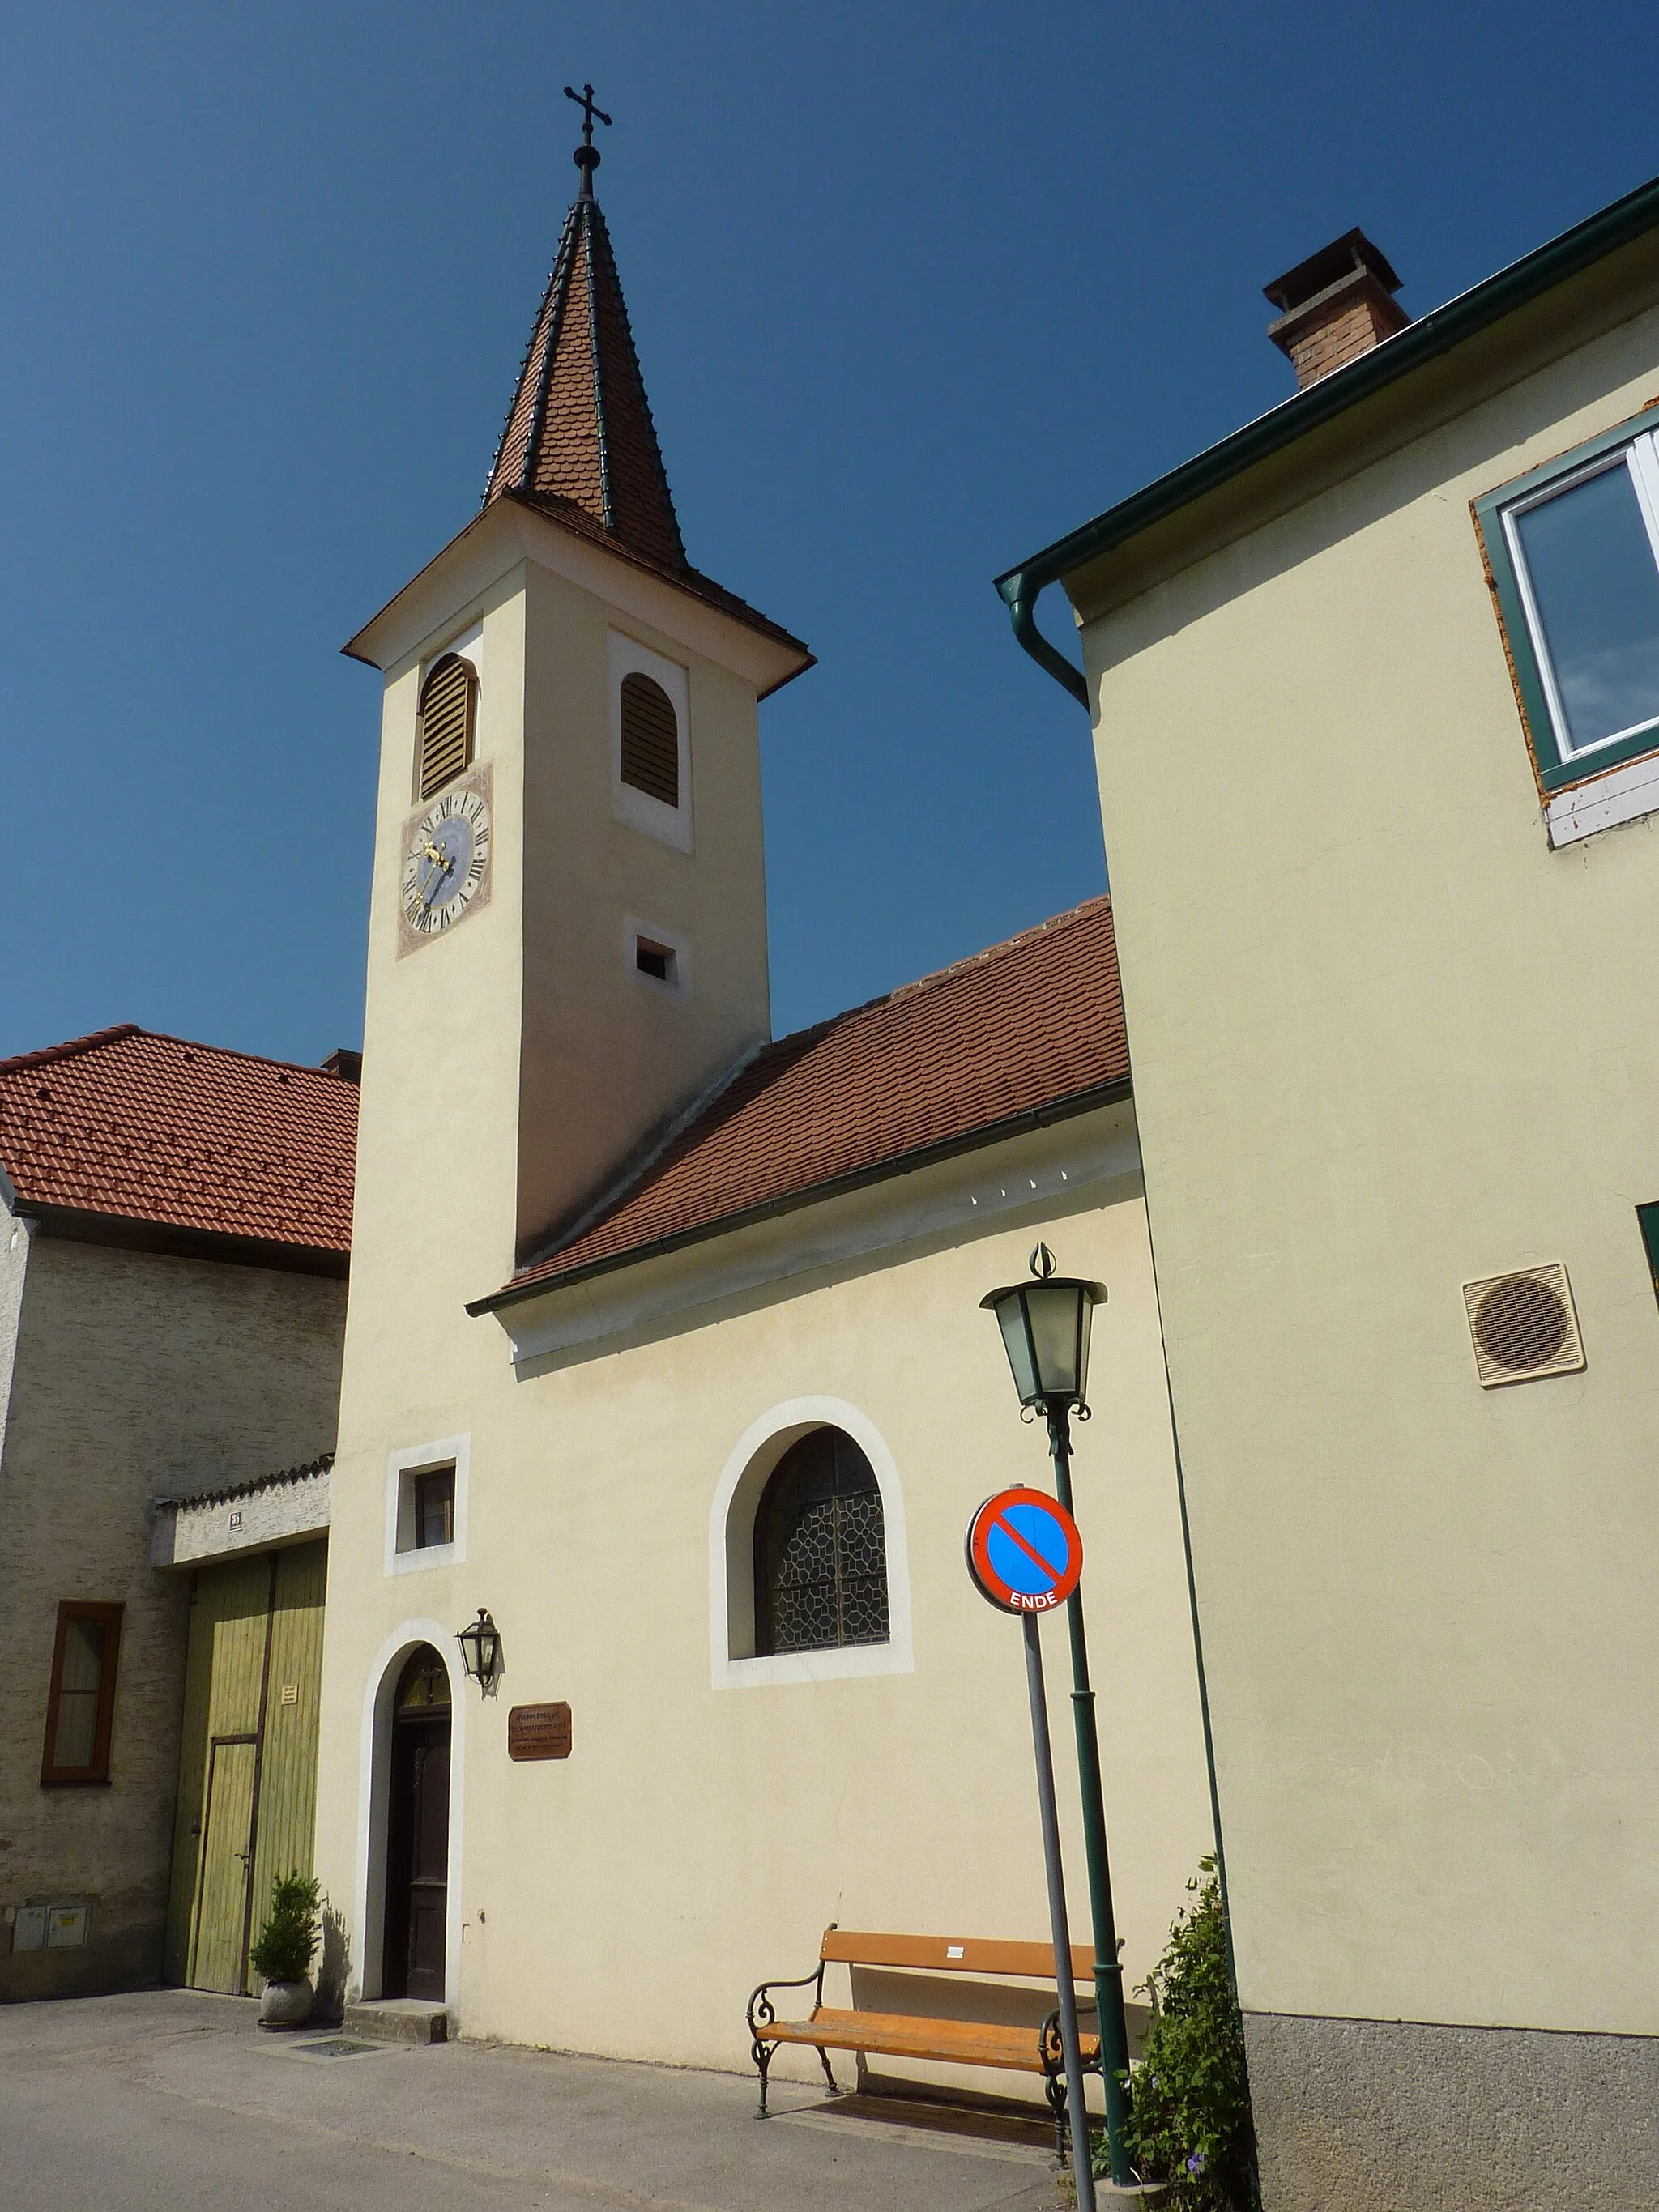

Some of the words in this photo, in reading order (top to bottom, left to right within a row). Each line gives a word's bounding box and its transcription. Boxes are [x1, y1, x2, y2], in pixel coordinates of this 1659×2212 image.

[439, 795, 452, 820] XII
[470, 801, 484, 824] II
[420, 816, 435, 834] XI
[475, 826, 489, 846] III
[1010, 1591, 1058, 1609] ENDE
